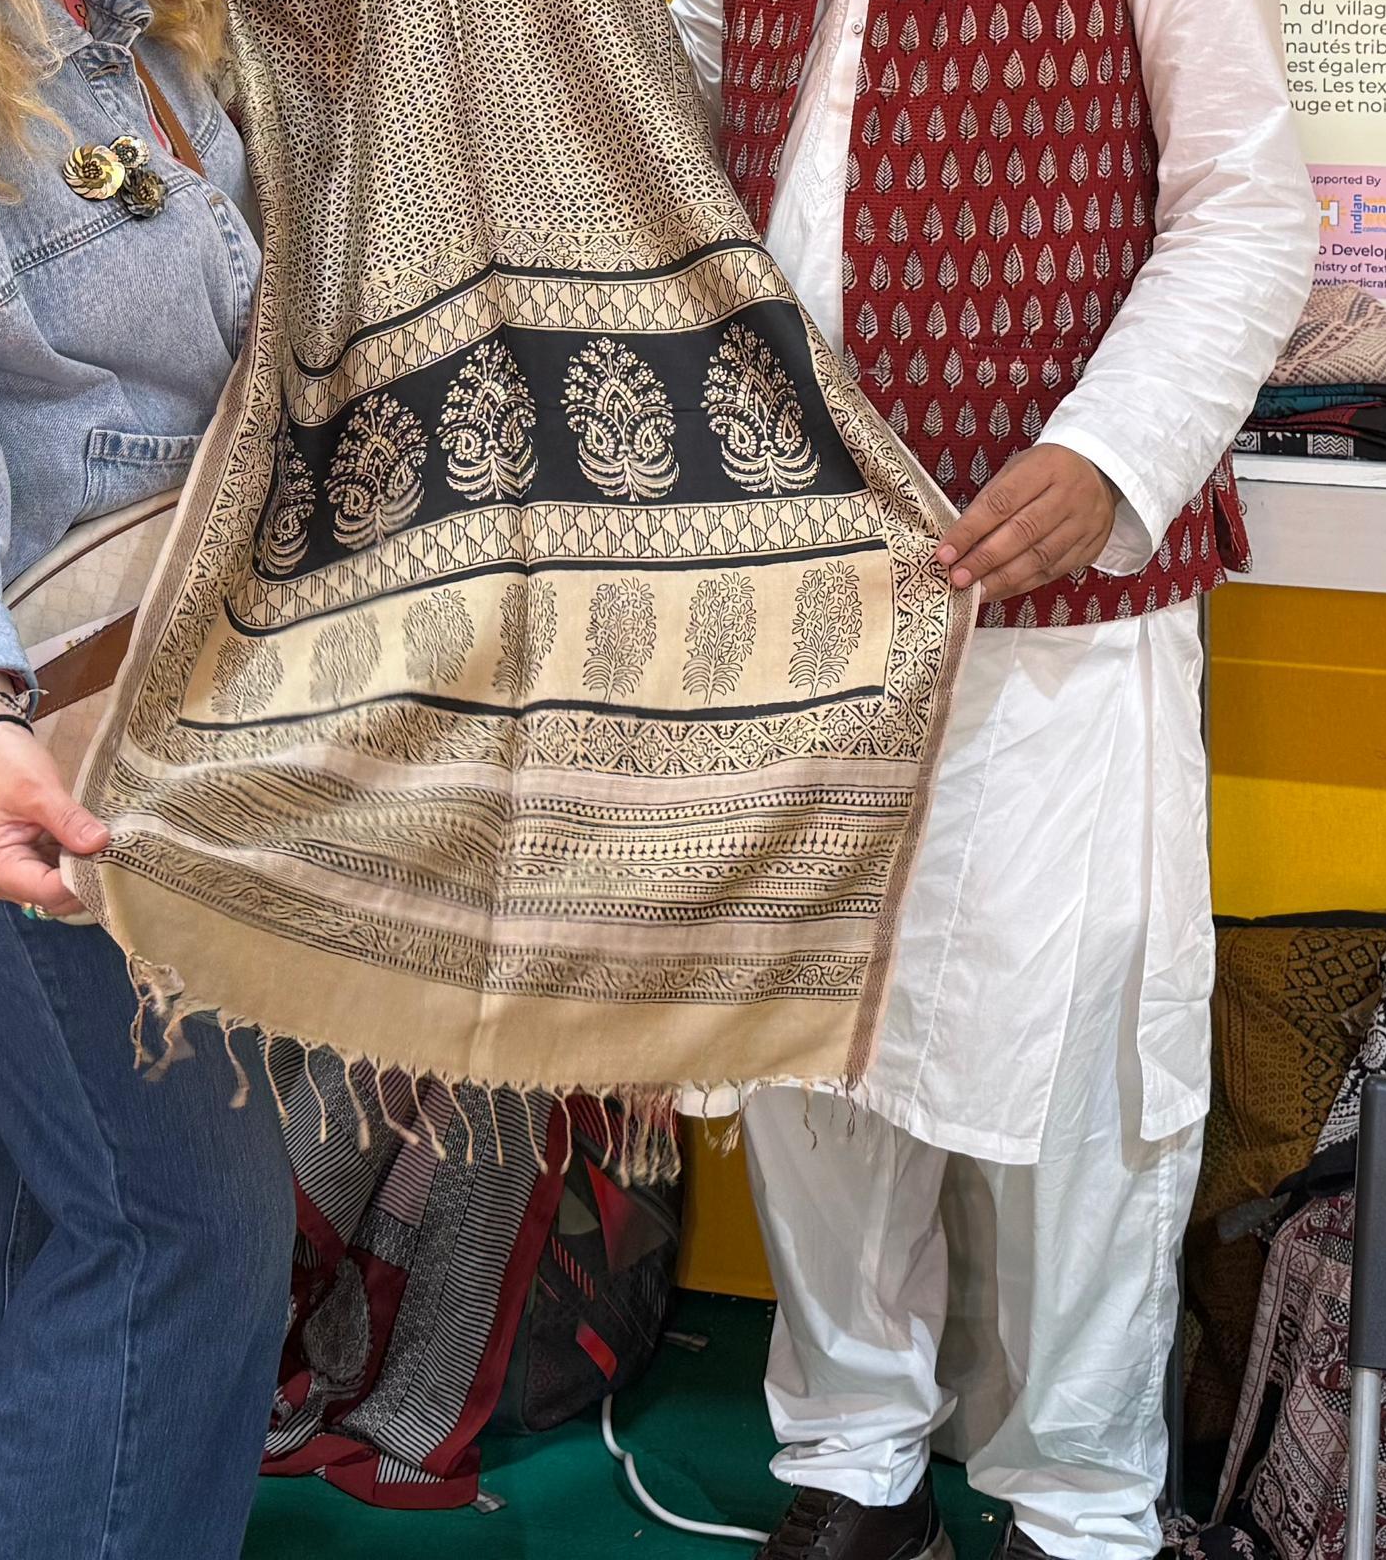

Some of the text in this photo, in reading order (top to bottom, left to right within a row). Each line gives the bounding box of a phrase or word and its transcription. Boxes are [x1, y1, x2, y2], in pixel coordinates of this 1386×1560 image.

[1286, 59, 1315, 72] est
[1322, 77, 1354, 93] Les
[1366, 175, 1381, 187] By
[1350, 193, 1362, 234] indian
[1349, 262, 1361, 272] of
